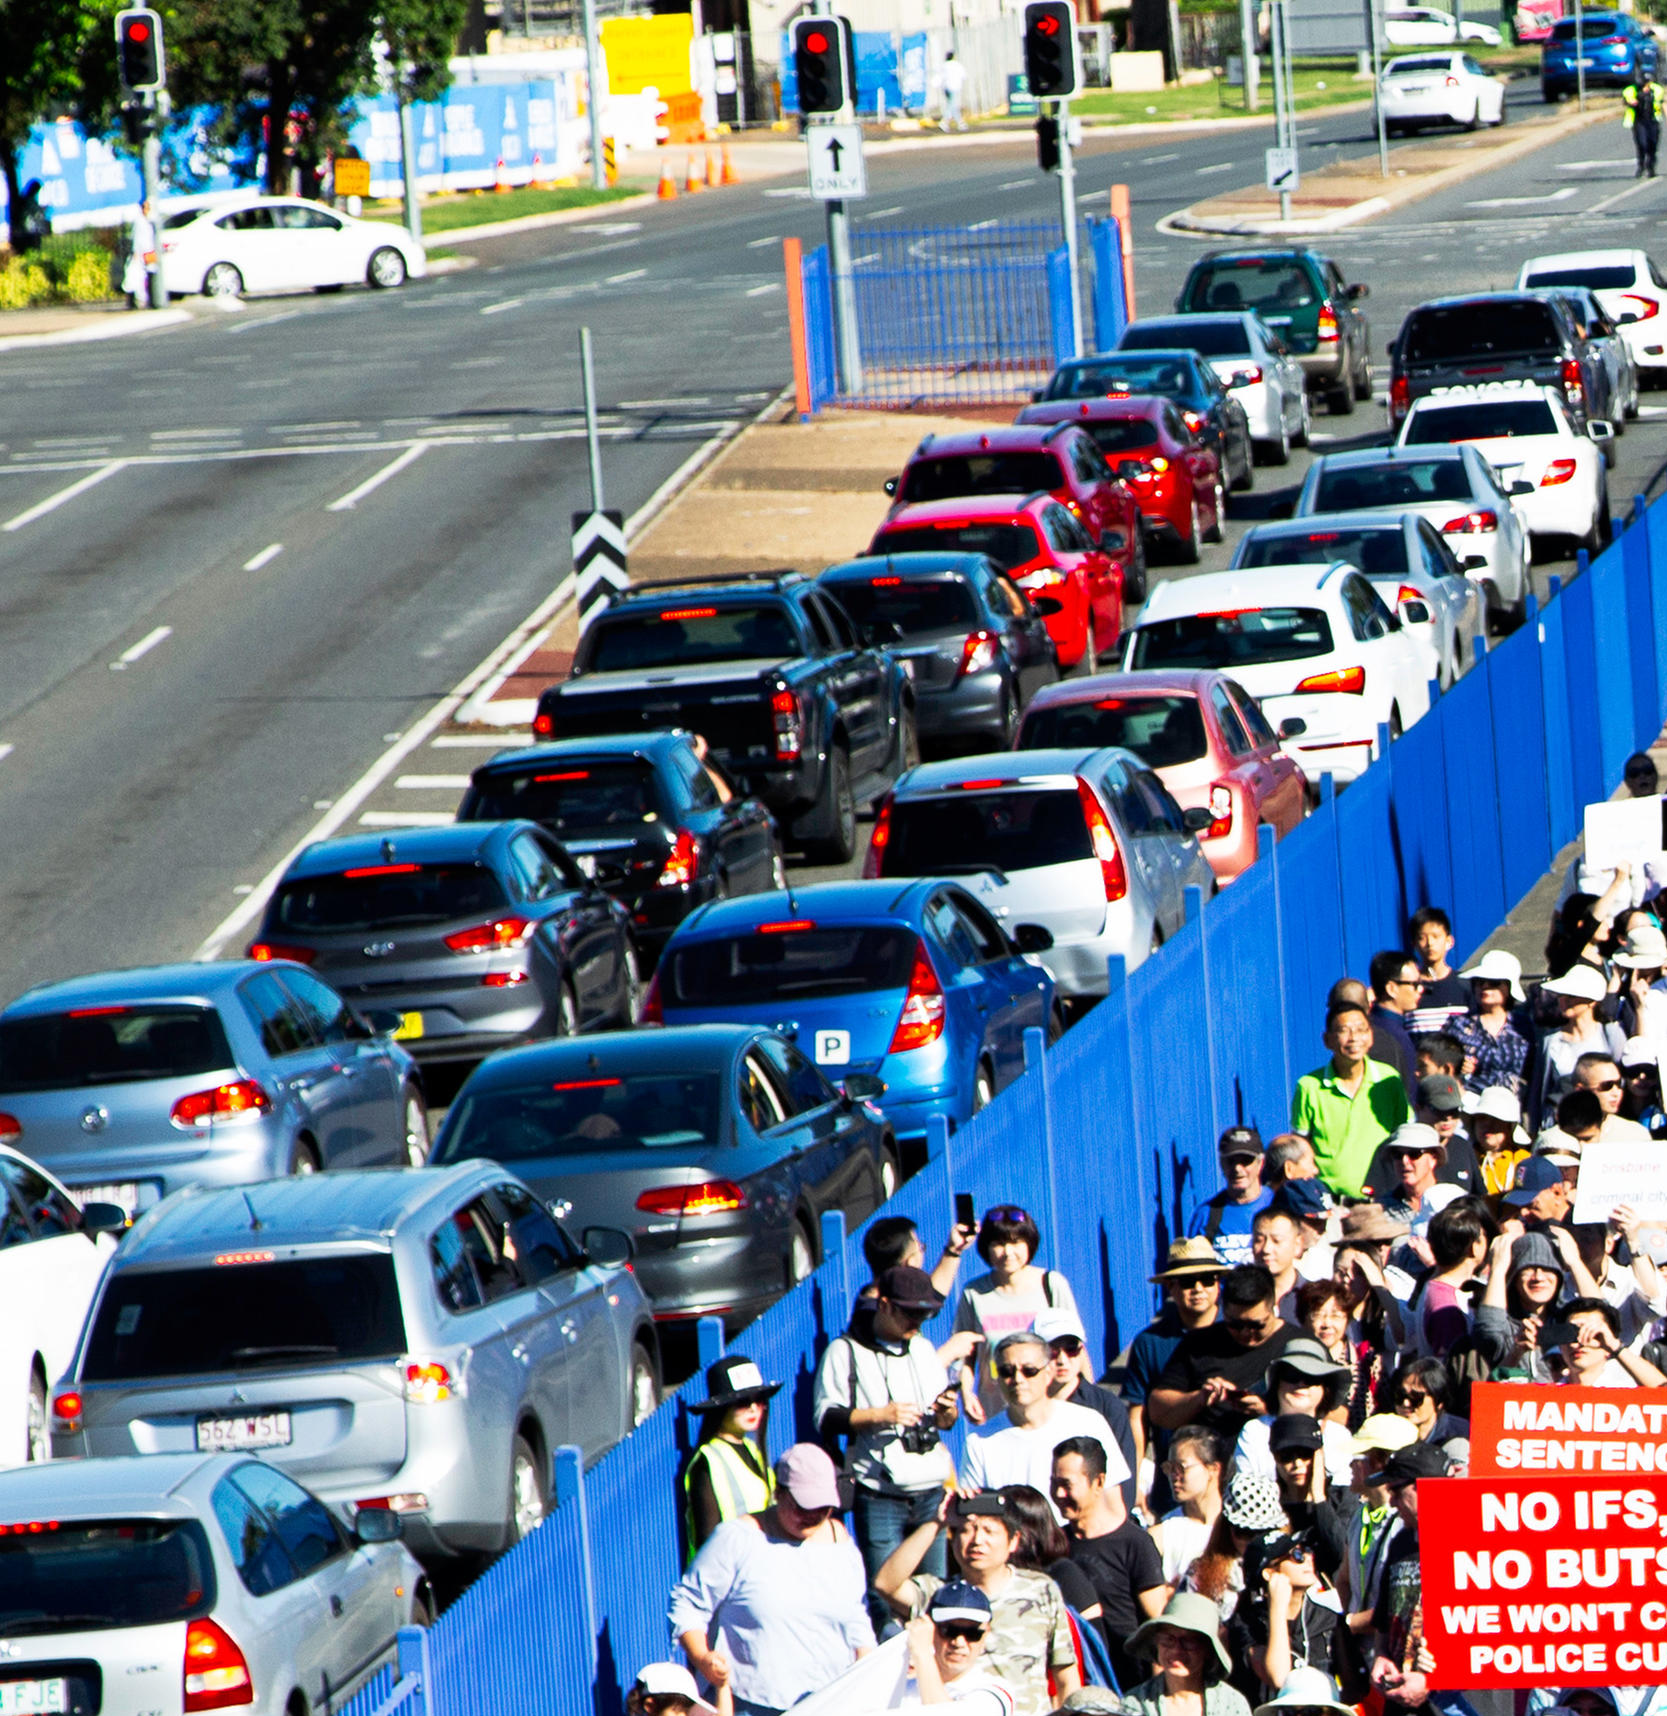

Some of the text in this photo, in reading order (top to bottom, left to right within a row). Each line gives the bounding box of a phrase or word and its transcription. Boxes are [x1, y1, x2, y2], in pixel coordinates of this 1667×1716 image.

[815, 177, 858, 191] ONLY
[824, 1036, 842, 1058] P
[199, 1413, 287, 1442] 562 WSL
[1481, 1491, 1561, 1532] NO
[1453, 1549, 1533, 1590] NO
[1441, 1605, 1501, 1635] WE
[1507, 1602, 1633, 1634] WON'T
[1470, 1643, 1608, 1674] POLICE
